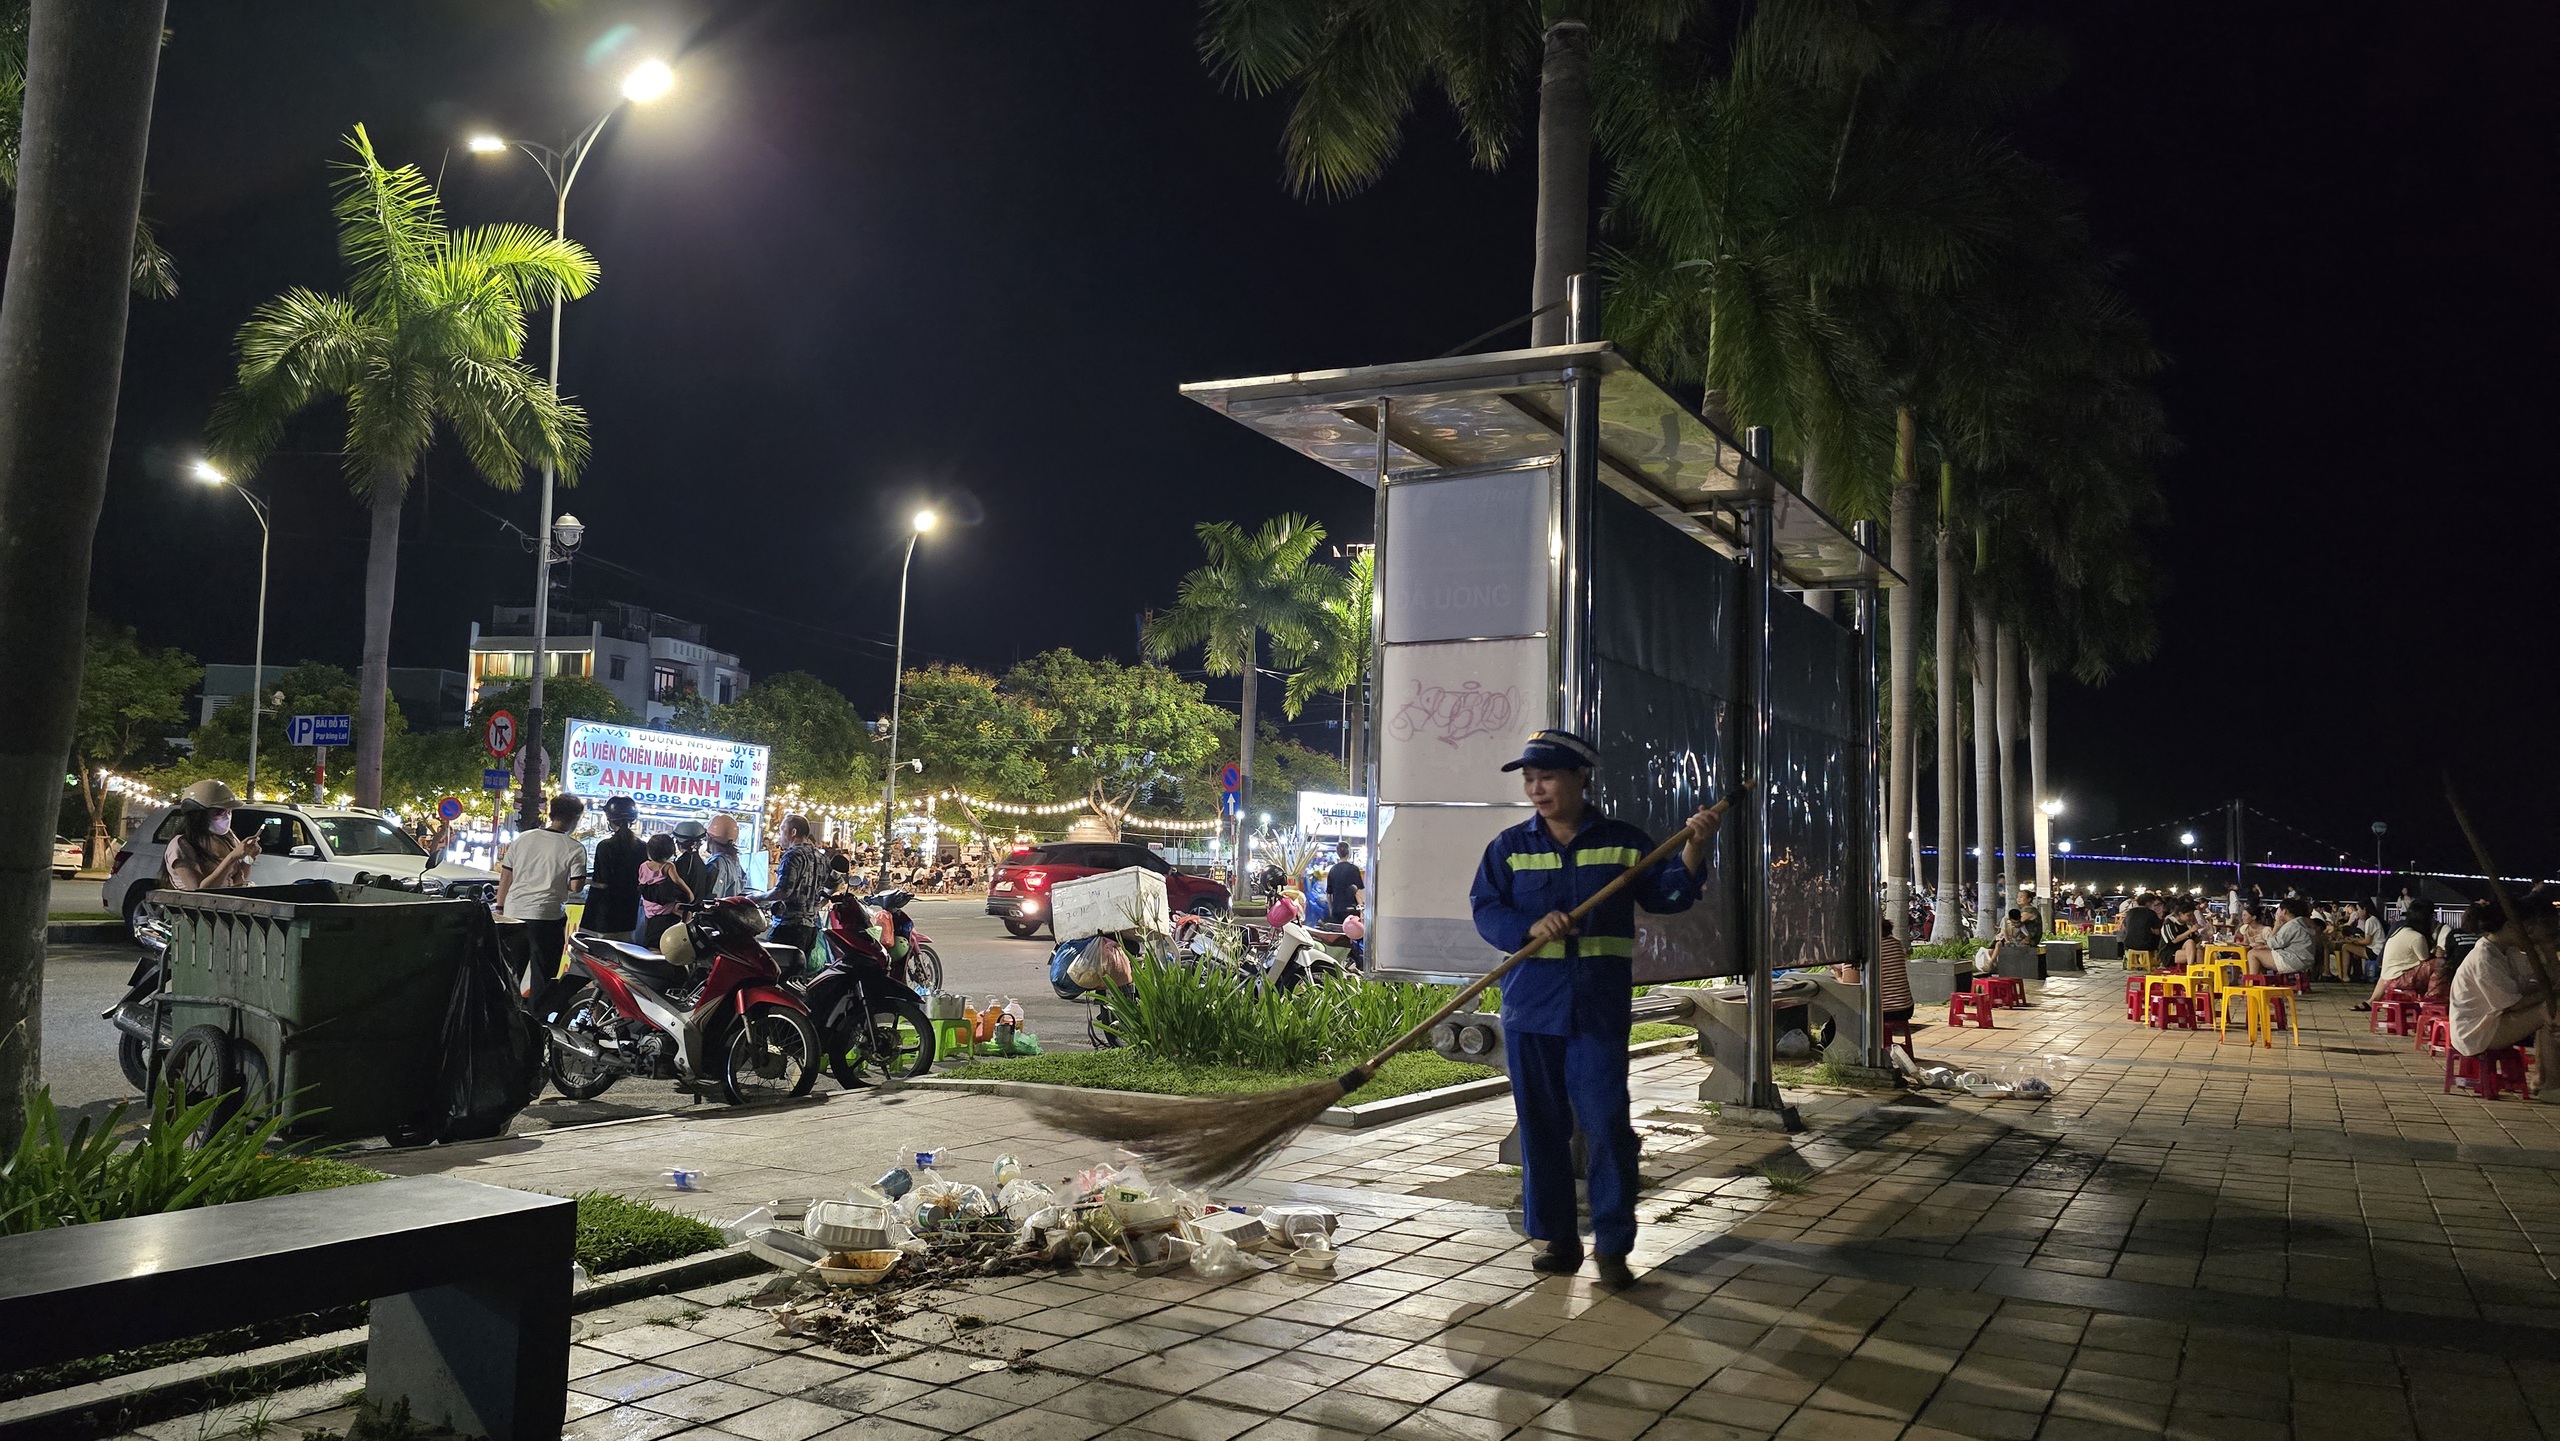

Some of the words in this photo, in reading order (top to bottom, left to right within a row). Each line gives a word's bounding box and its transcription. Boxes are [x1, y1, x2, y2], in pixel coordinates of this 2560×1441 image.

[298, 718, 313, 743] P
[339, 719, 348, 728] XE
[573, 736, 587, 758] CÁ
[592, 740, 617, 762] VIÊN
[620, 745, 652, 766] CHIÊN
[701, 754, 724, 779] BIỆT
[598, 767, 652, 791] ANH
[723, 773, 748, 786] TRỨNG
[725, 788, 744, 801] MUỐI
